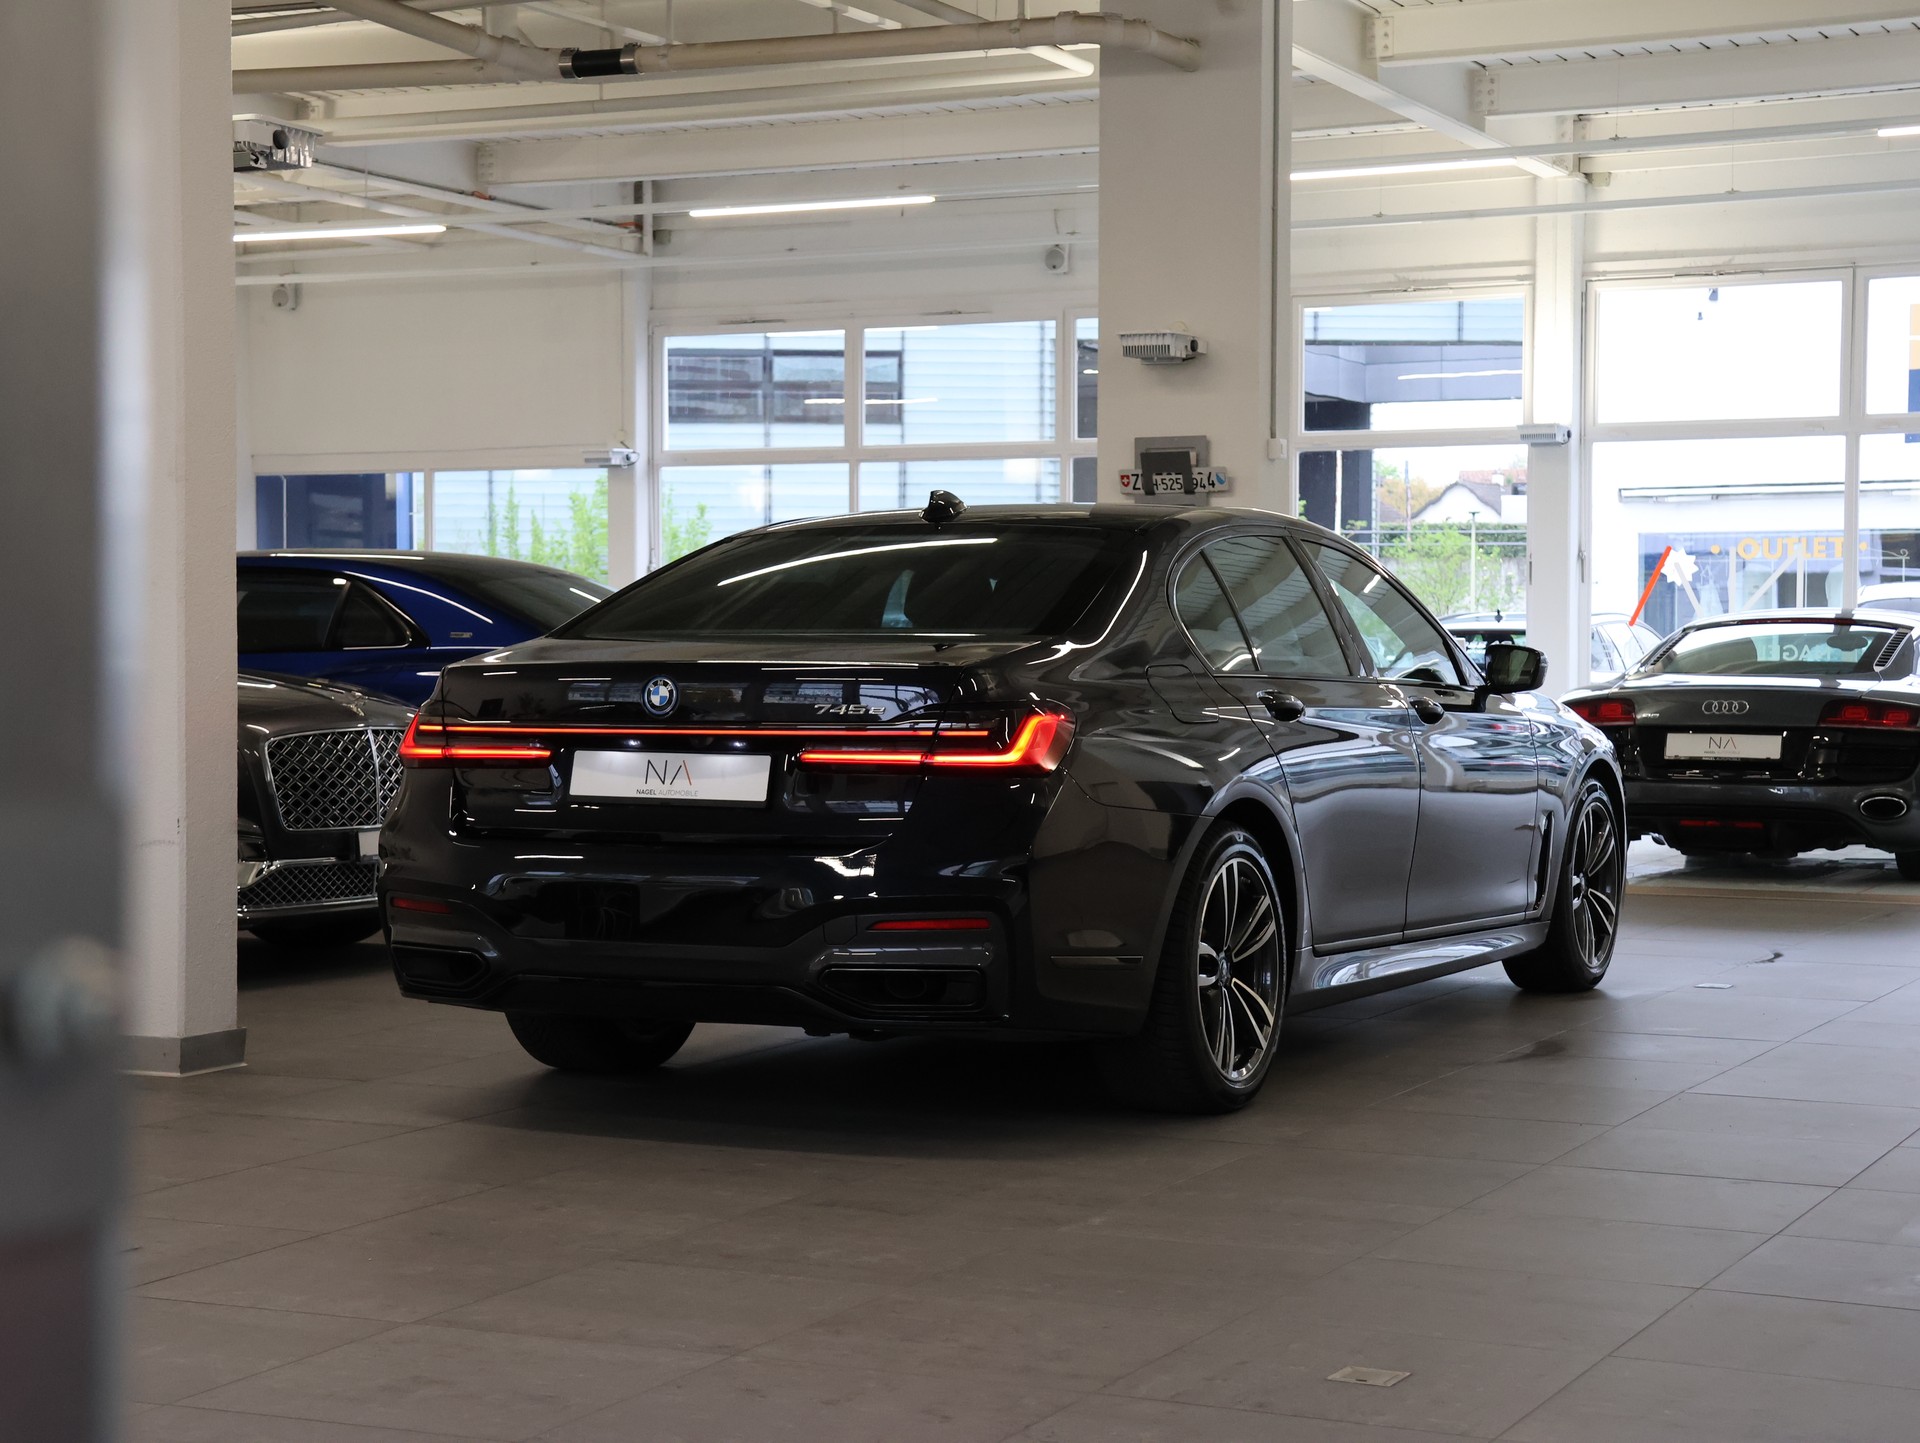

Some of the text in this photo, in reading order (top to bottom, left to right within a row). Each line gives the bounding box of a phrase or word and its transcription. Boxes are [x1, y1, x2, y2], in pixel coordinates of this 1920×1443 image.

[1737, 536, 1845, 560] OUTLET
[814, 703, 886, 715] 745e
[636, 788, 699, 797] NAGEL AUTOMOBILE
